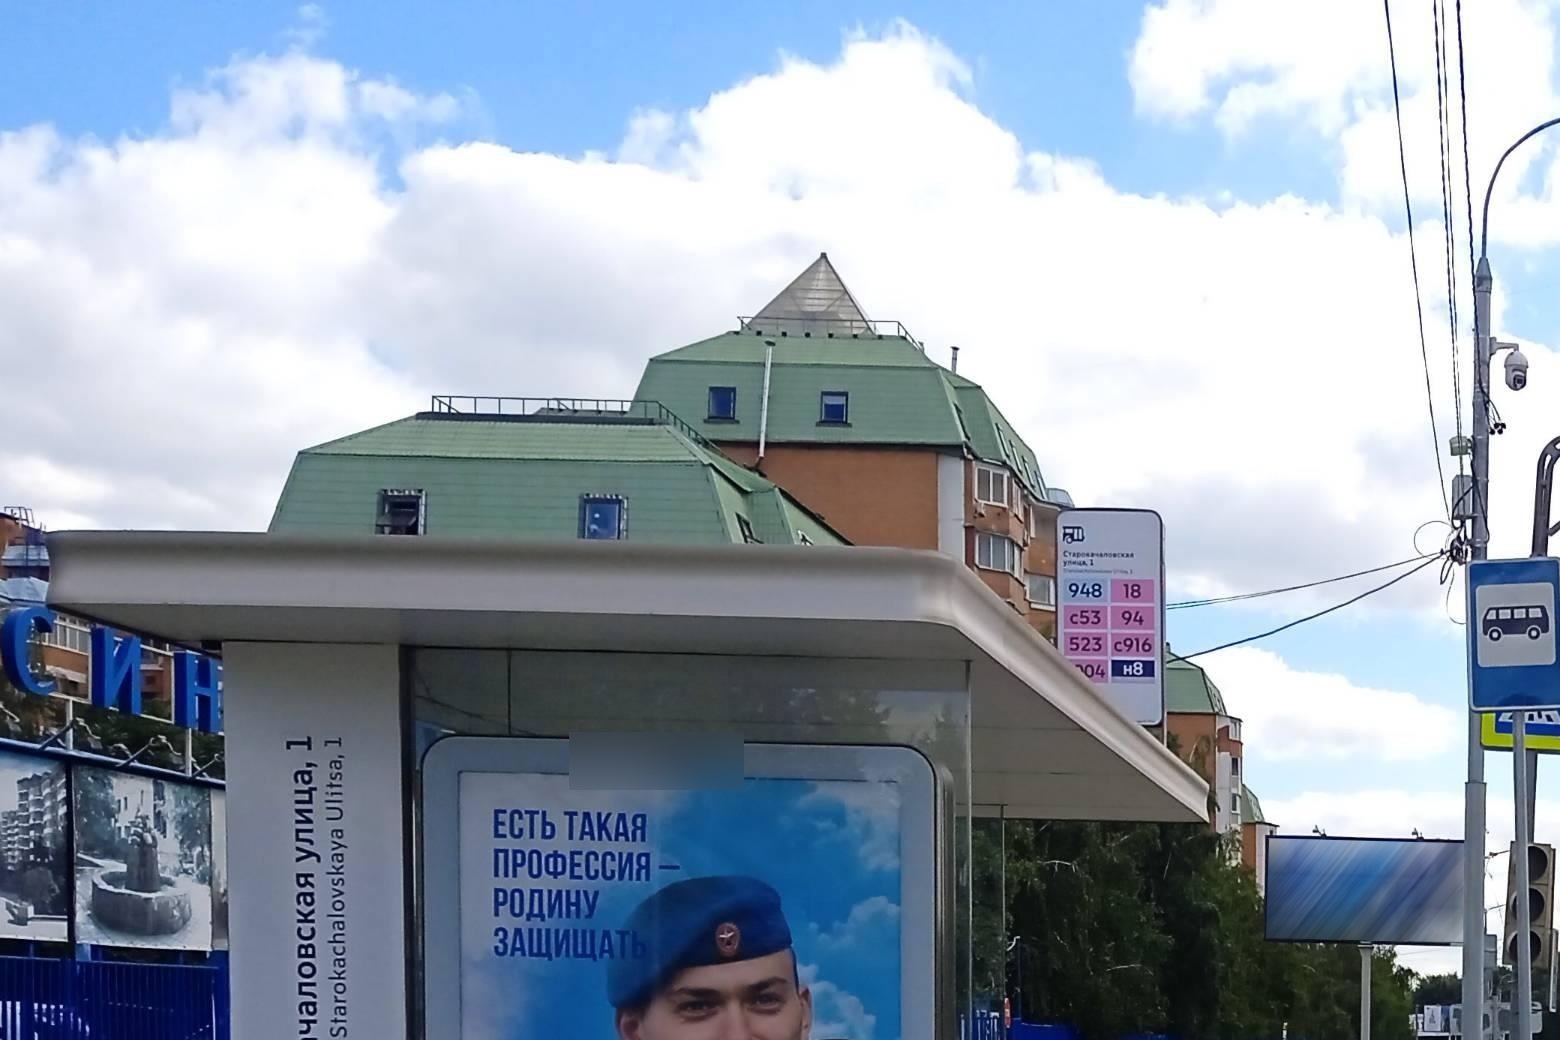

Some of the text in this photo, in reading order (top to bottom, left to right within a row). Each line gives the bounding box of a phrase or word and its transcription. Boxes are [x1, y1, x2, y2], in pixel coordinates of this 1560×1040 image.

[1063, 550, 1135, 558] Старокачаловская
[1068, 582, 1102, 598] 948
[1123, 583, 1142, 599] 18
[1070, 610, 1101, 625] с53
[1121, 610, 1144, 625] 94
[1069, 637, 1102, 651] 523
[1114, 637, 1152, 652] с916
[1123, 661, 1143, 676] н8
[286, 736, 313, 750] 1
[293, 762, 321, 863] улица,
[493, 808, 648, 843] ЕСТЬ ТАКАЯ
[493, 848, 651, 882] ПРОФЕССИЯ
[324, 737, 348, 1038] Starokachalovskaya Ulitsa, 1
[493, 887, 600, 922] РОДИНУ
[493, 926, 648, 962] ЗАЩИЩАТЬ
